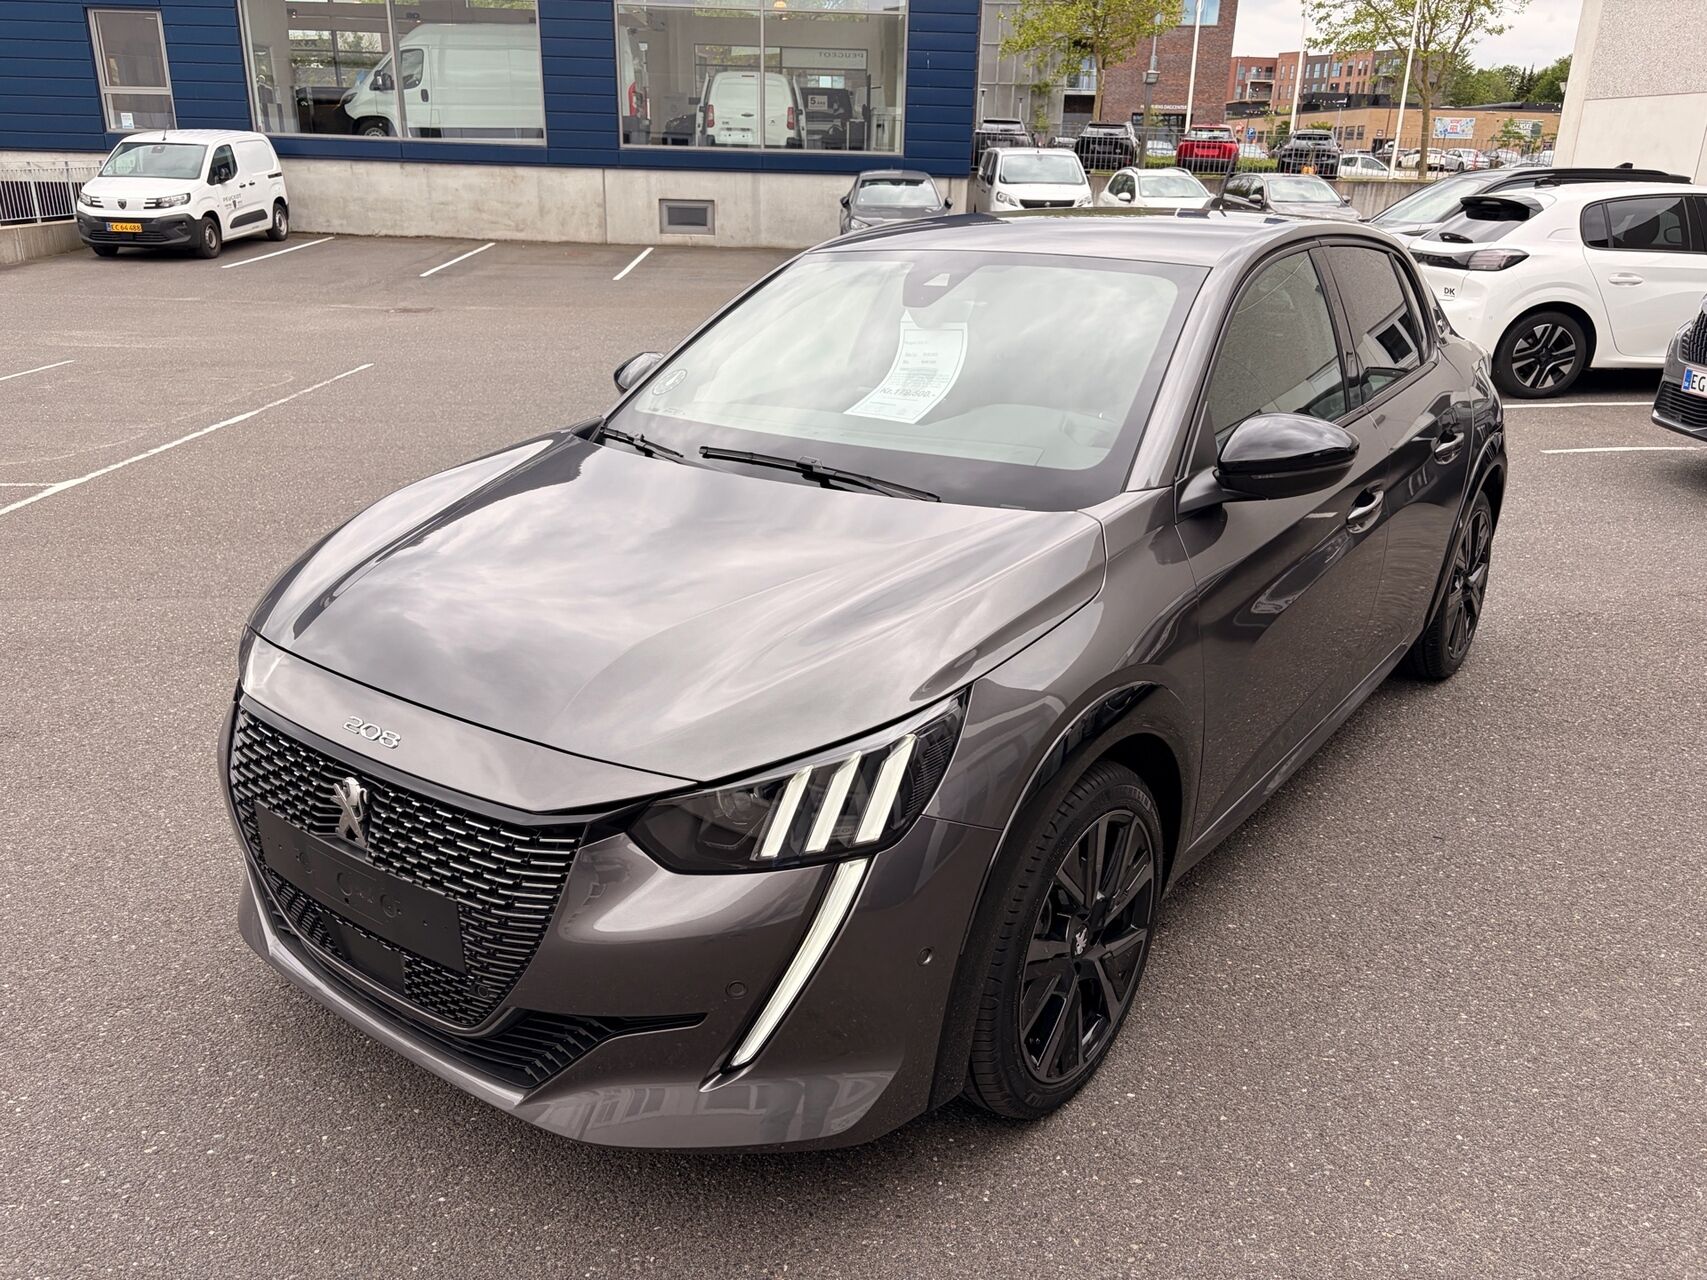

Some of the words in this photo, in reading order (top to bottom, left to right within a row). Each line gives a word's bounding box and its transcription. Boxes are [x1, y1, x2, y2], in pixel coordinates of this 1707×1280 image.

[1444, 287, 1455, 295] DK
[1691, 374, 1706, 392] EG
[343, 715, 401, 749] 208
